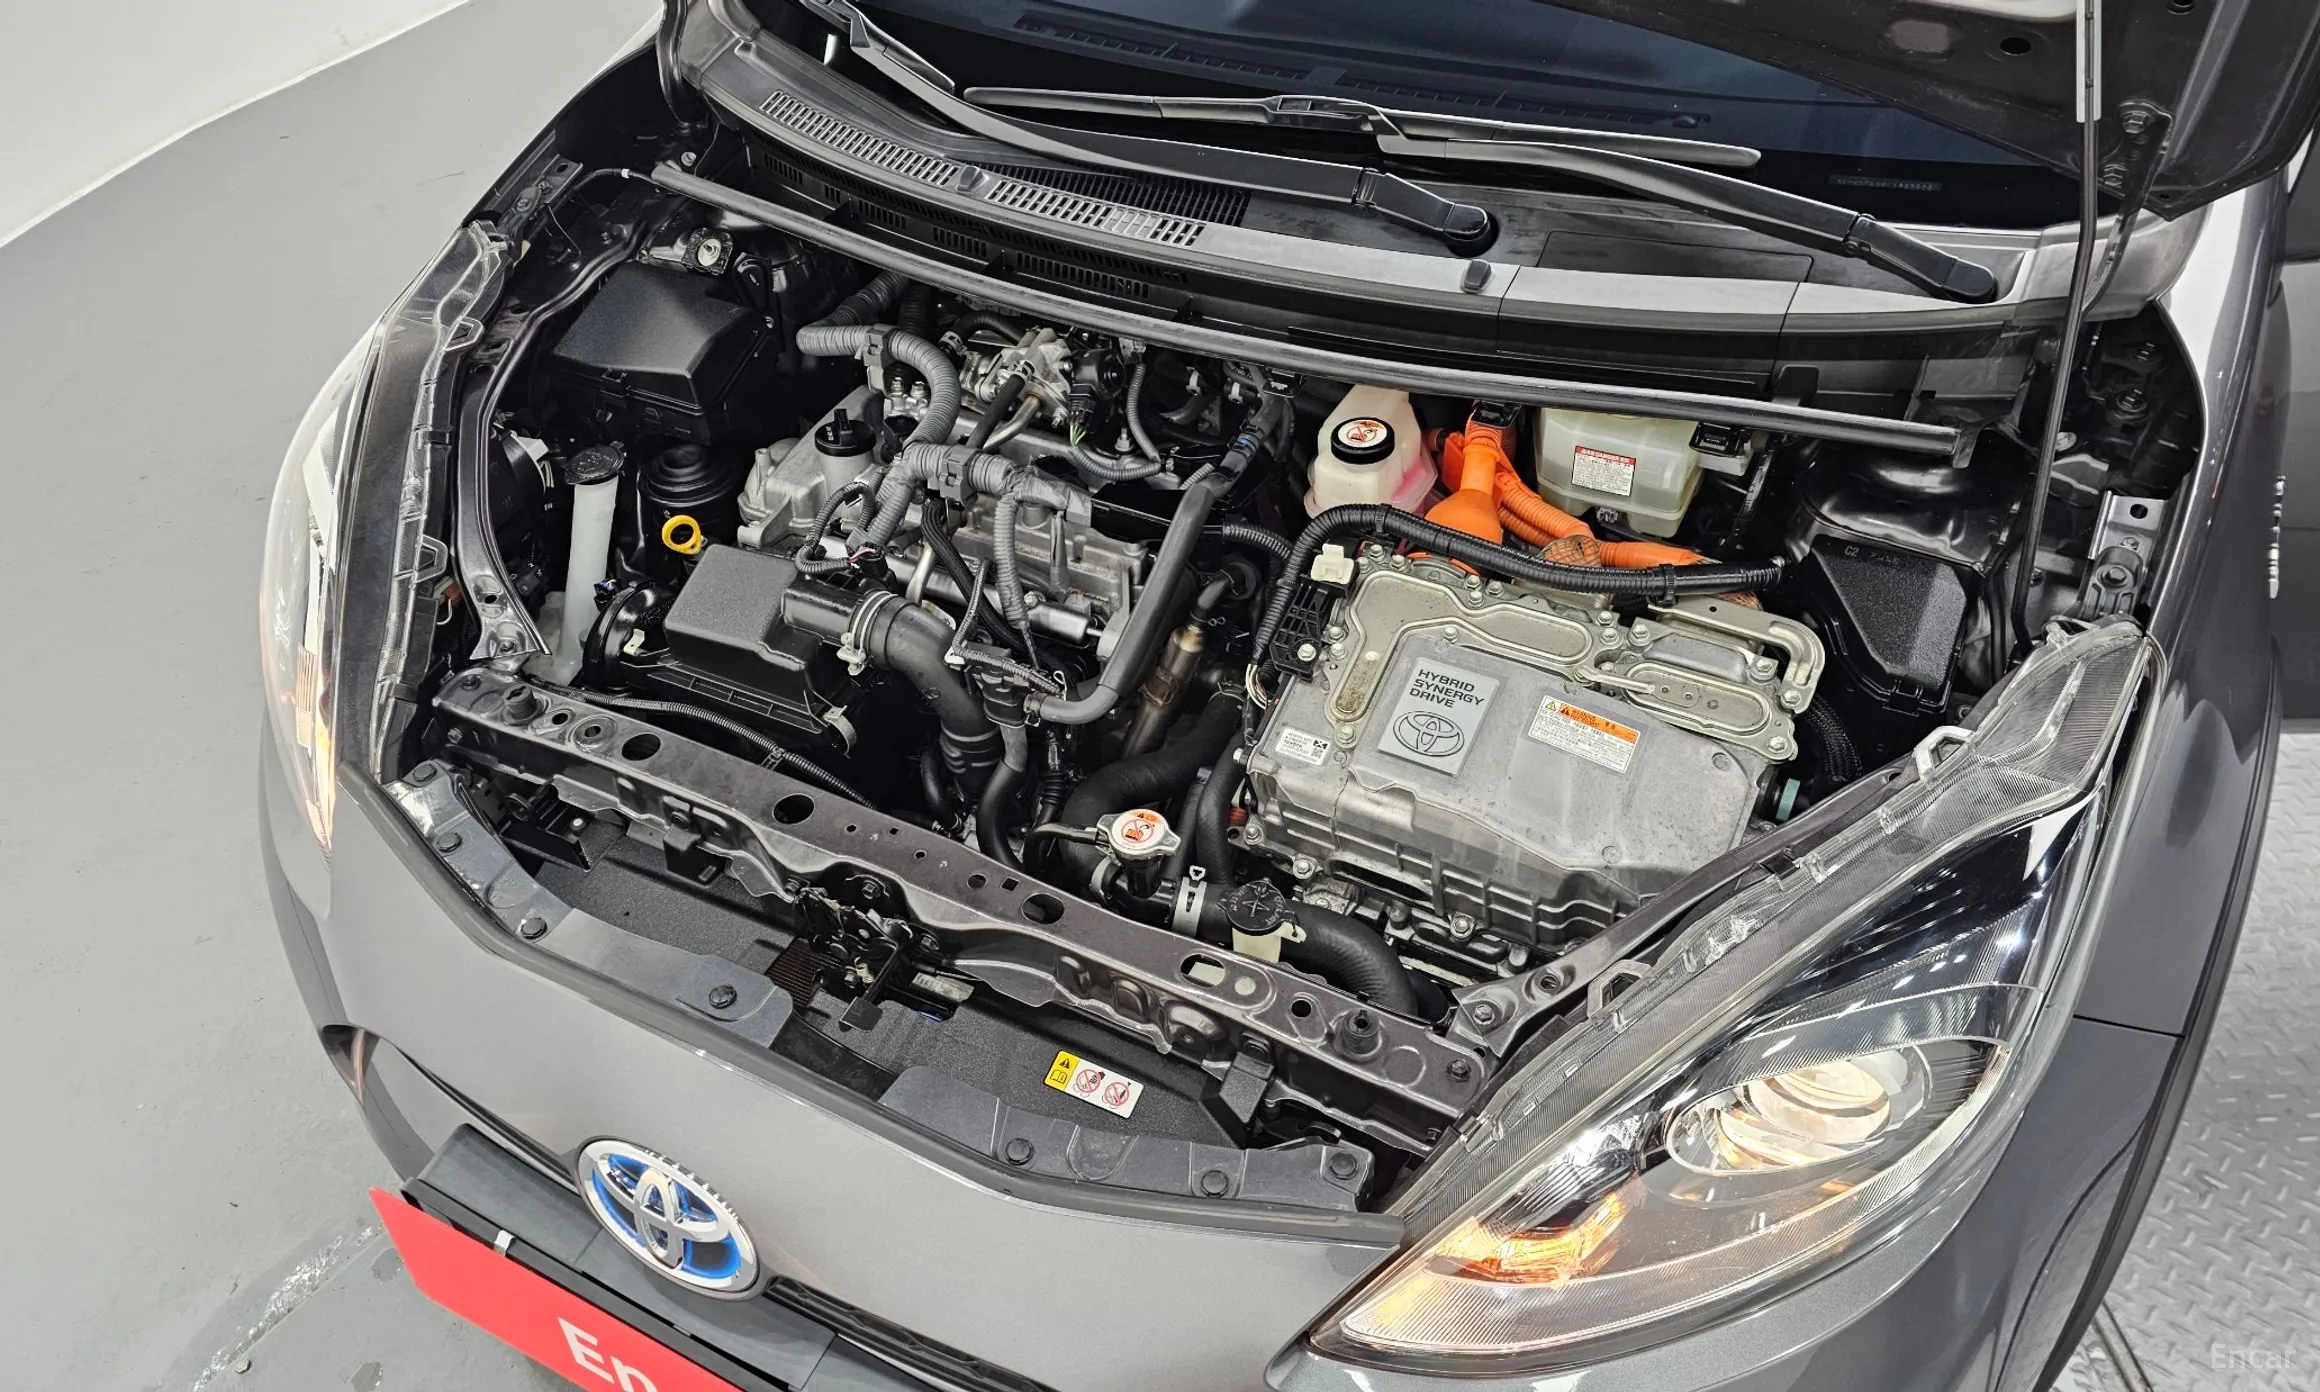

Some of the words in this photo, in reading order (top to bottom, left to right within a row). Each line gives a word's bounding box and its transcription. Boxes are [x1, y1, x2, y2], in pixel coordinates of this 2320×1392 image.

[1413, 678, 1485, 706] SYNERGY
[1418, 669, 1475, 693] HYBRID
[1409, 688, 1456, 708] DRIVE
